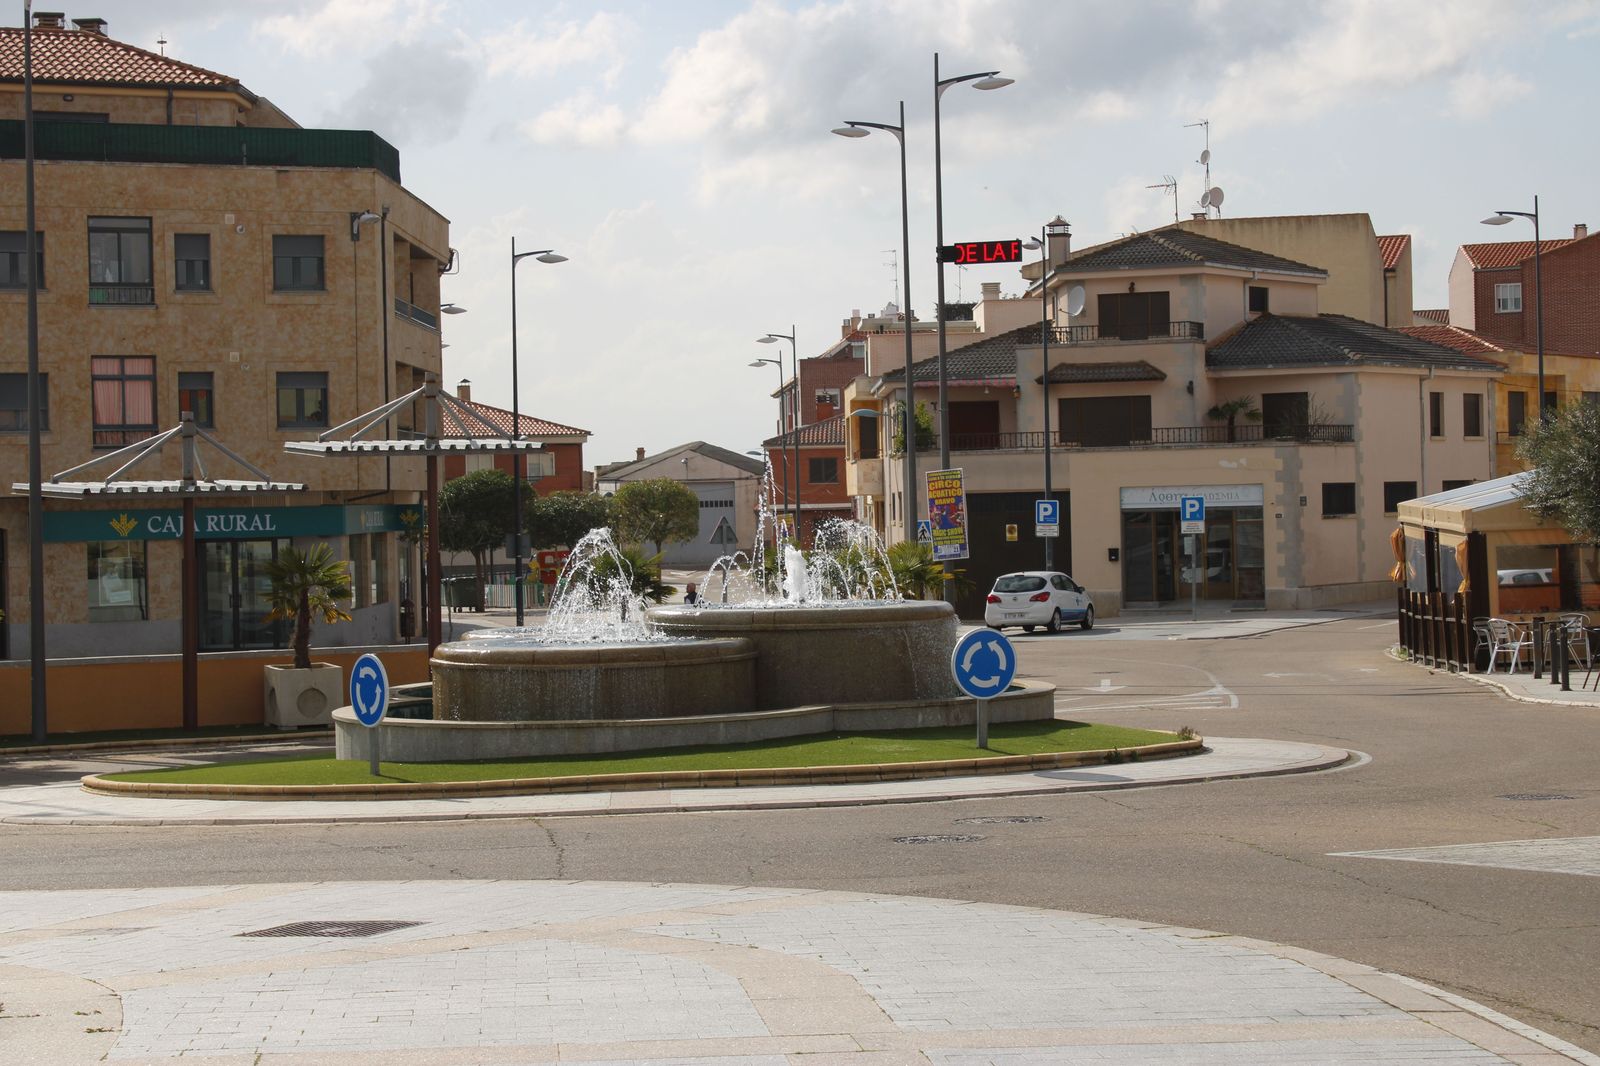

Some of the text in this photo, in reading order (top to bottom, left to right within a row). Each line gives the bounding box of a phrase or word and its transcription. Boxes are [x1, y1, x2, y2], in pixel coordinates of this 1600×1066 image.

[983, 243, 1007, 262] LA
[929, 480, 961, 491] CIRCO
[1039, 503, 1053, 522] P
[1186, 500, 1200, 519] P
[206, 514, 277, 532] RURAL
